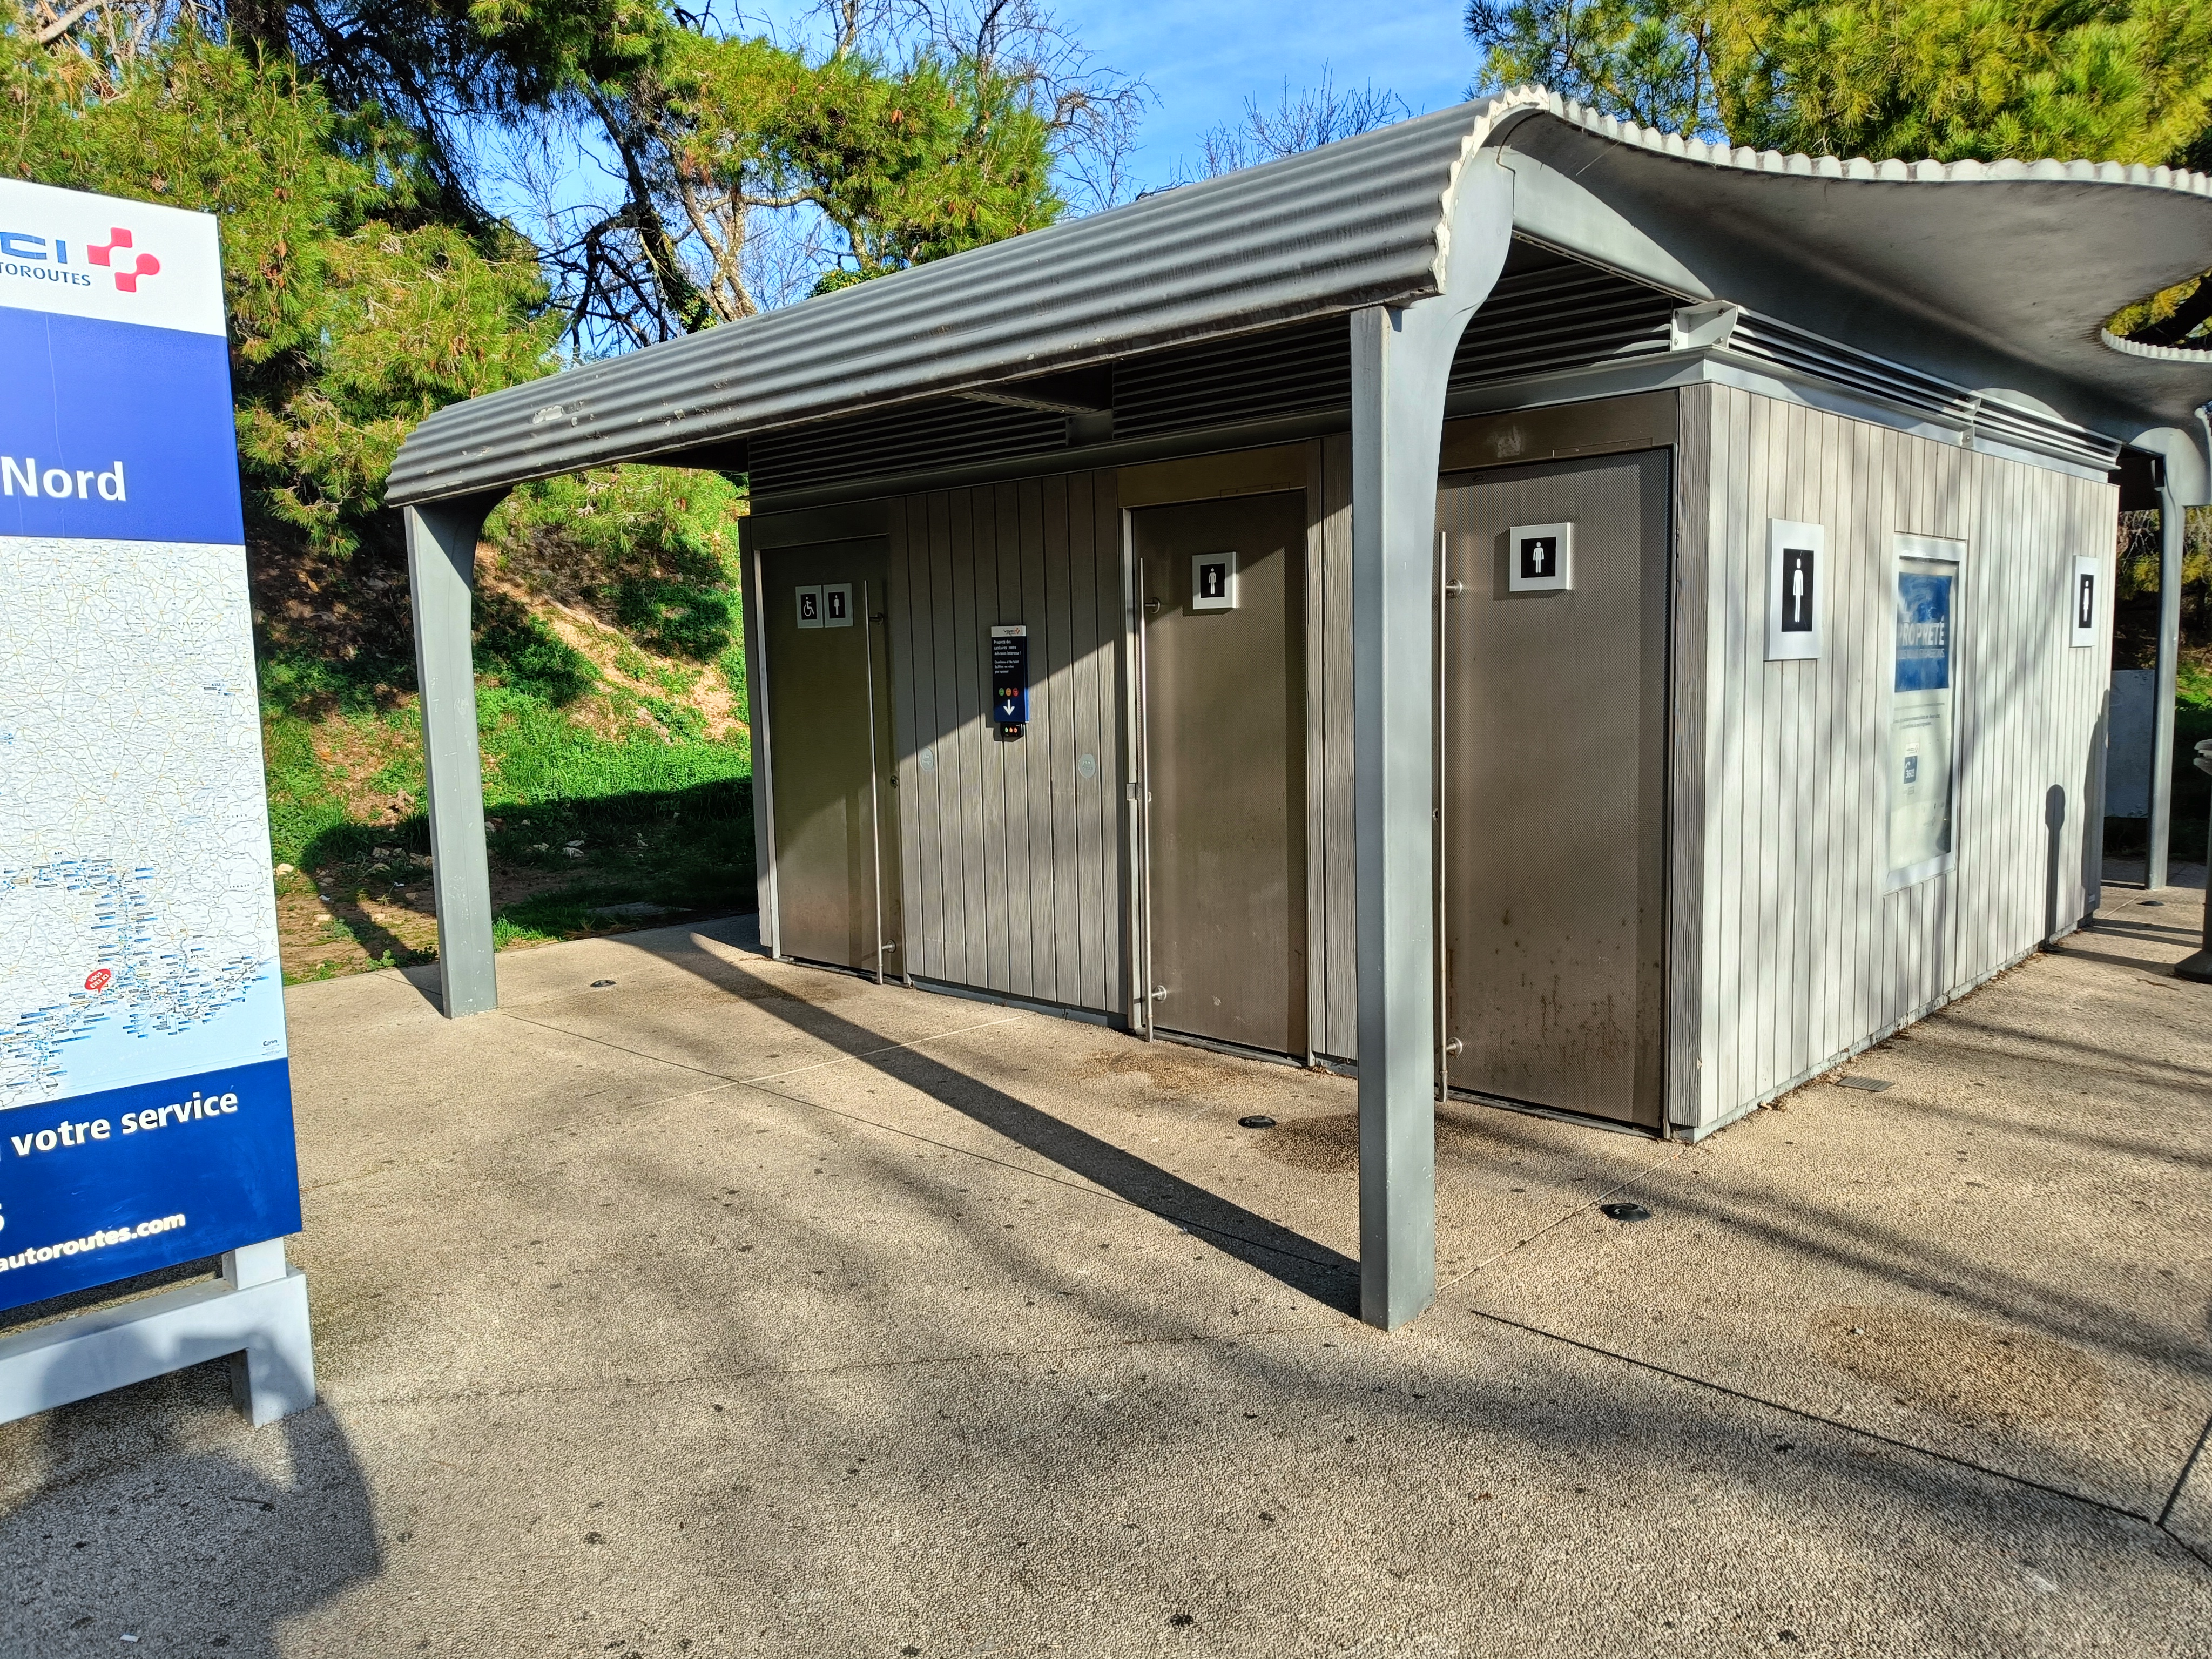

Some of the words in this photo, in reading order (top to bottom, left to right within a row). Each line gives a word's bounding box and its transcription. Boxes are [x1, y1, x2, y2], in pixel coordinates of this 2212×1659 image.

[1, 456, 126, 502] Nord
[88, 972, 103, 982] VOUS
[10, 1120, 110, 1157] votre
[120, 1091, 238, 1135] service
[0, 1213, 186, 1272] autoroutes.com
